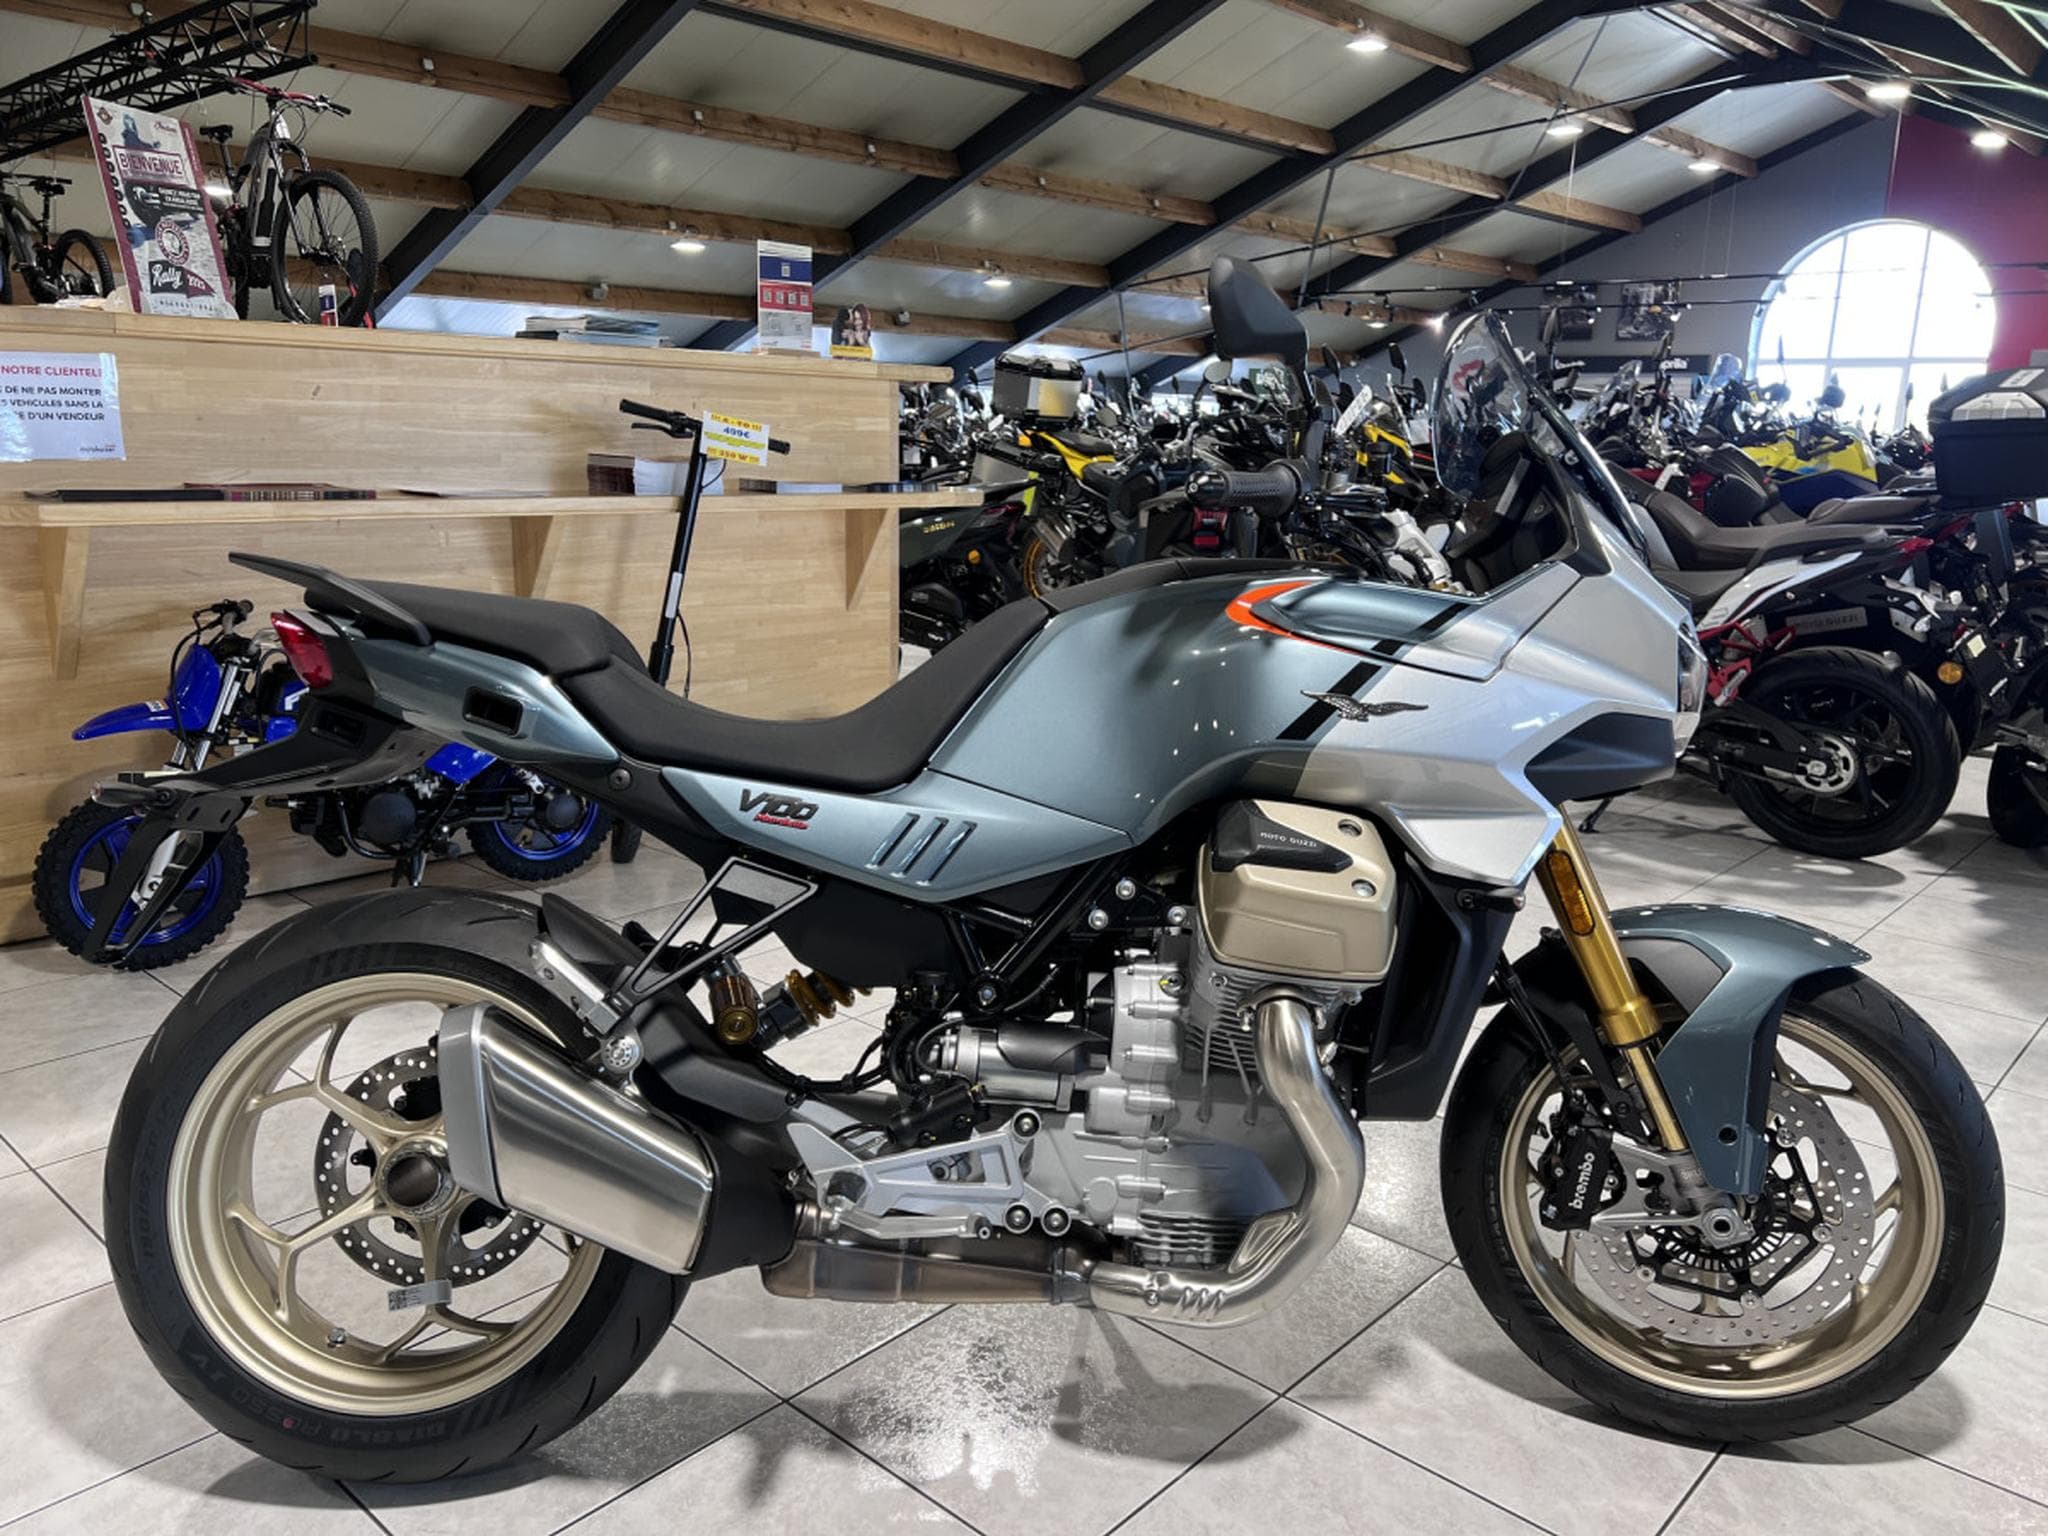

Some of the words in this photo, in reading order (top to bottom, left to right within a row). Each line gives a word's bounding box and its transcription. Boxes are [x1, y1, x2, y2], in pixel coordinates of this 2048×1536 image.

[119, 153, 183, 175] BIENVENUE
[151, 264, 184, 289] Rally
[1, 365, 42, 375] NOTRE
[4, 385, 18, 394] DE
[21, 386, 35, 394] NE
[37, 386, 57, 395] PAS
[59, 387, 102, 397] MONTER
[65, 401, 90, 409] SANS
[27, 411, 54, 420] D'UN
[56, 412, 105, 421] VENDEUR
[723, 426, 751, 438] 499€
[739, 788, 819, 821] V100
[1261, 831, 1286, 841] MOTO
[1289, 837, 1317, 847] GUZZI
[1567, 1151, 1596, 1210] brembo
[330, 1420, 447, 1446] DIABLO
